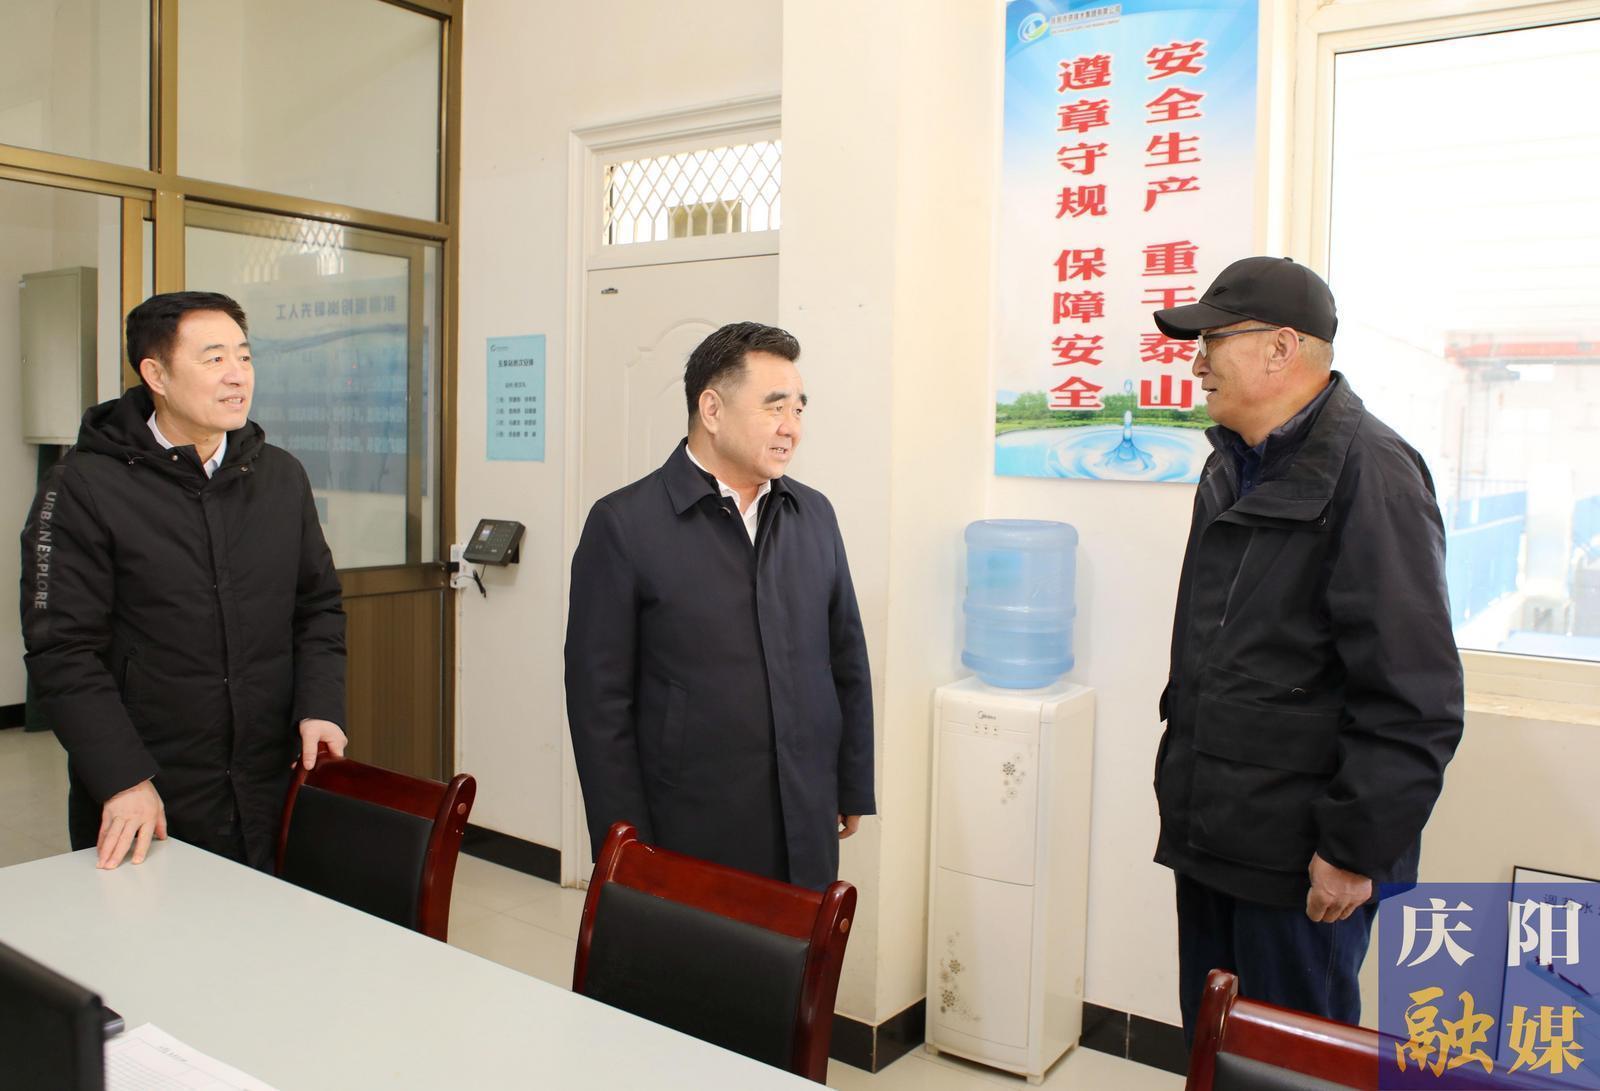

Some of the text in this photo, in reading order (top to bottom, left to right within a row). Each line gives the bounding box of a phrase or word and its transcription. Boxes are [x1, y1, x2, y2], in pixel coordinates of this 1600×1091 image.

[1055, 54, 1111, 219] 遵章守规
[1143, 41, 1205, 212] 安全生产
[1050, 247, 1106, 408] 保障安全
